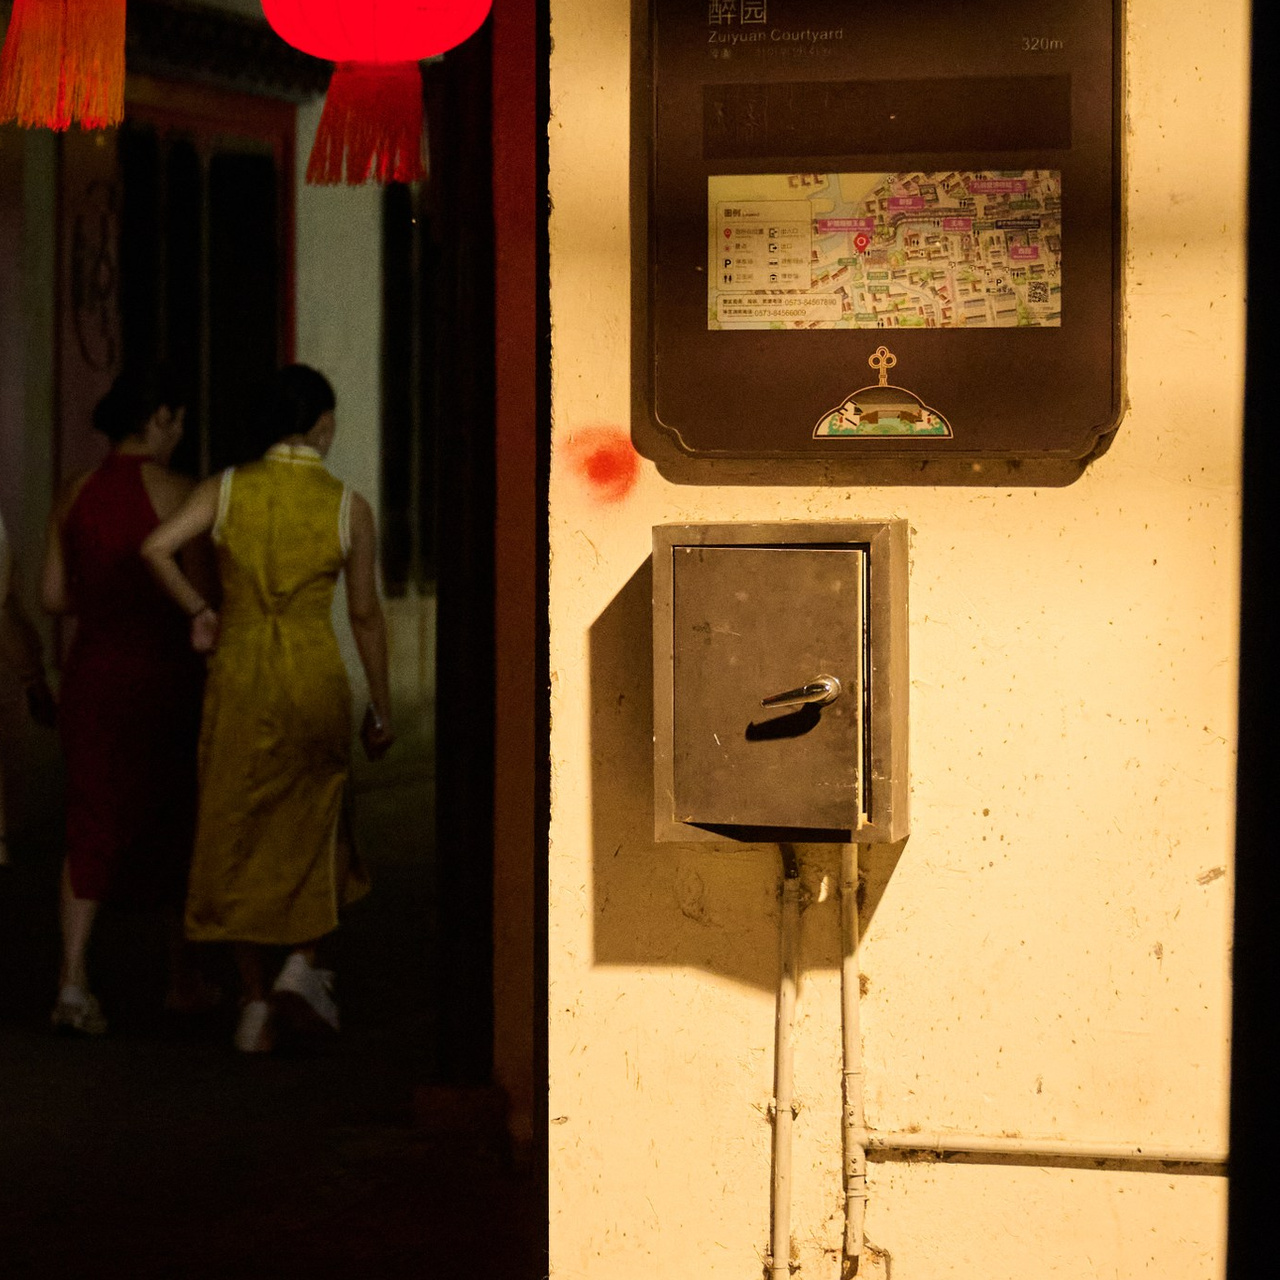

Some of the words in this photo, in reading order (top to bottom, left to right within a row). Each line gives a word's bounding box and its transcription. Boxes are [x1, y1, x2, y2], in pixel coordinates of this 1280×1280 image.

[707, 30, 767, 46] Zuiyuan
[770, 28, 844, 44] Courtyard
[1021, 37, 1064, 51] 320m
